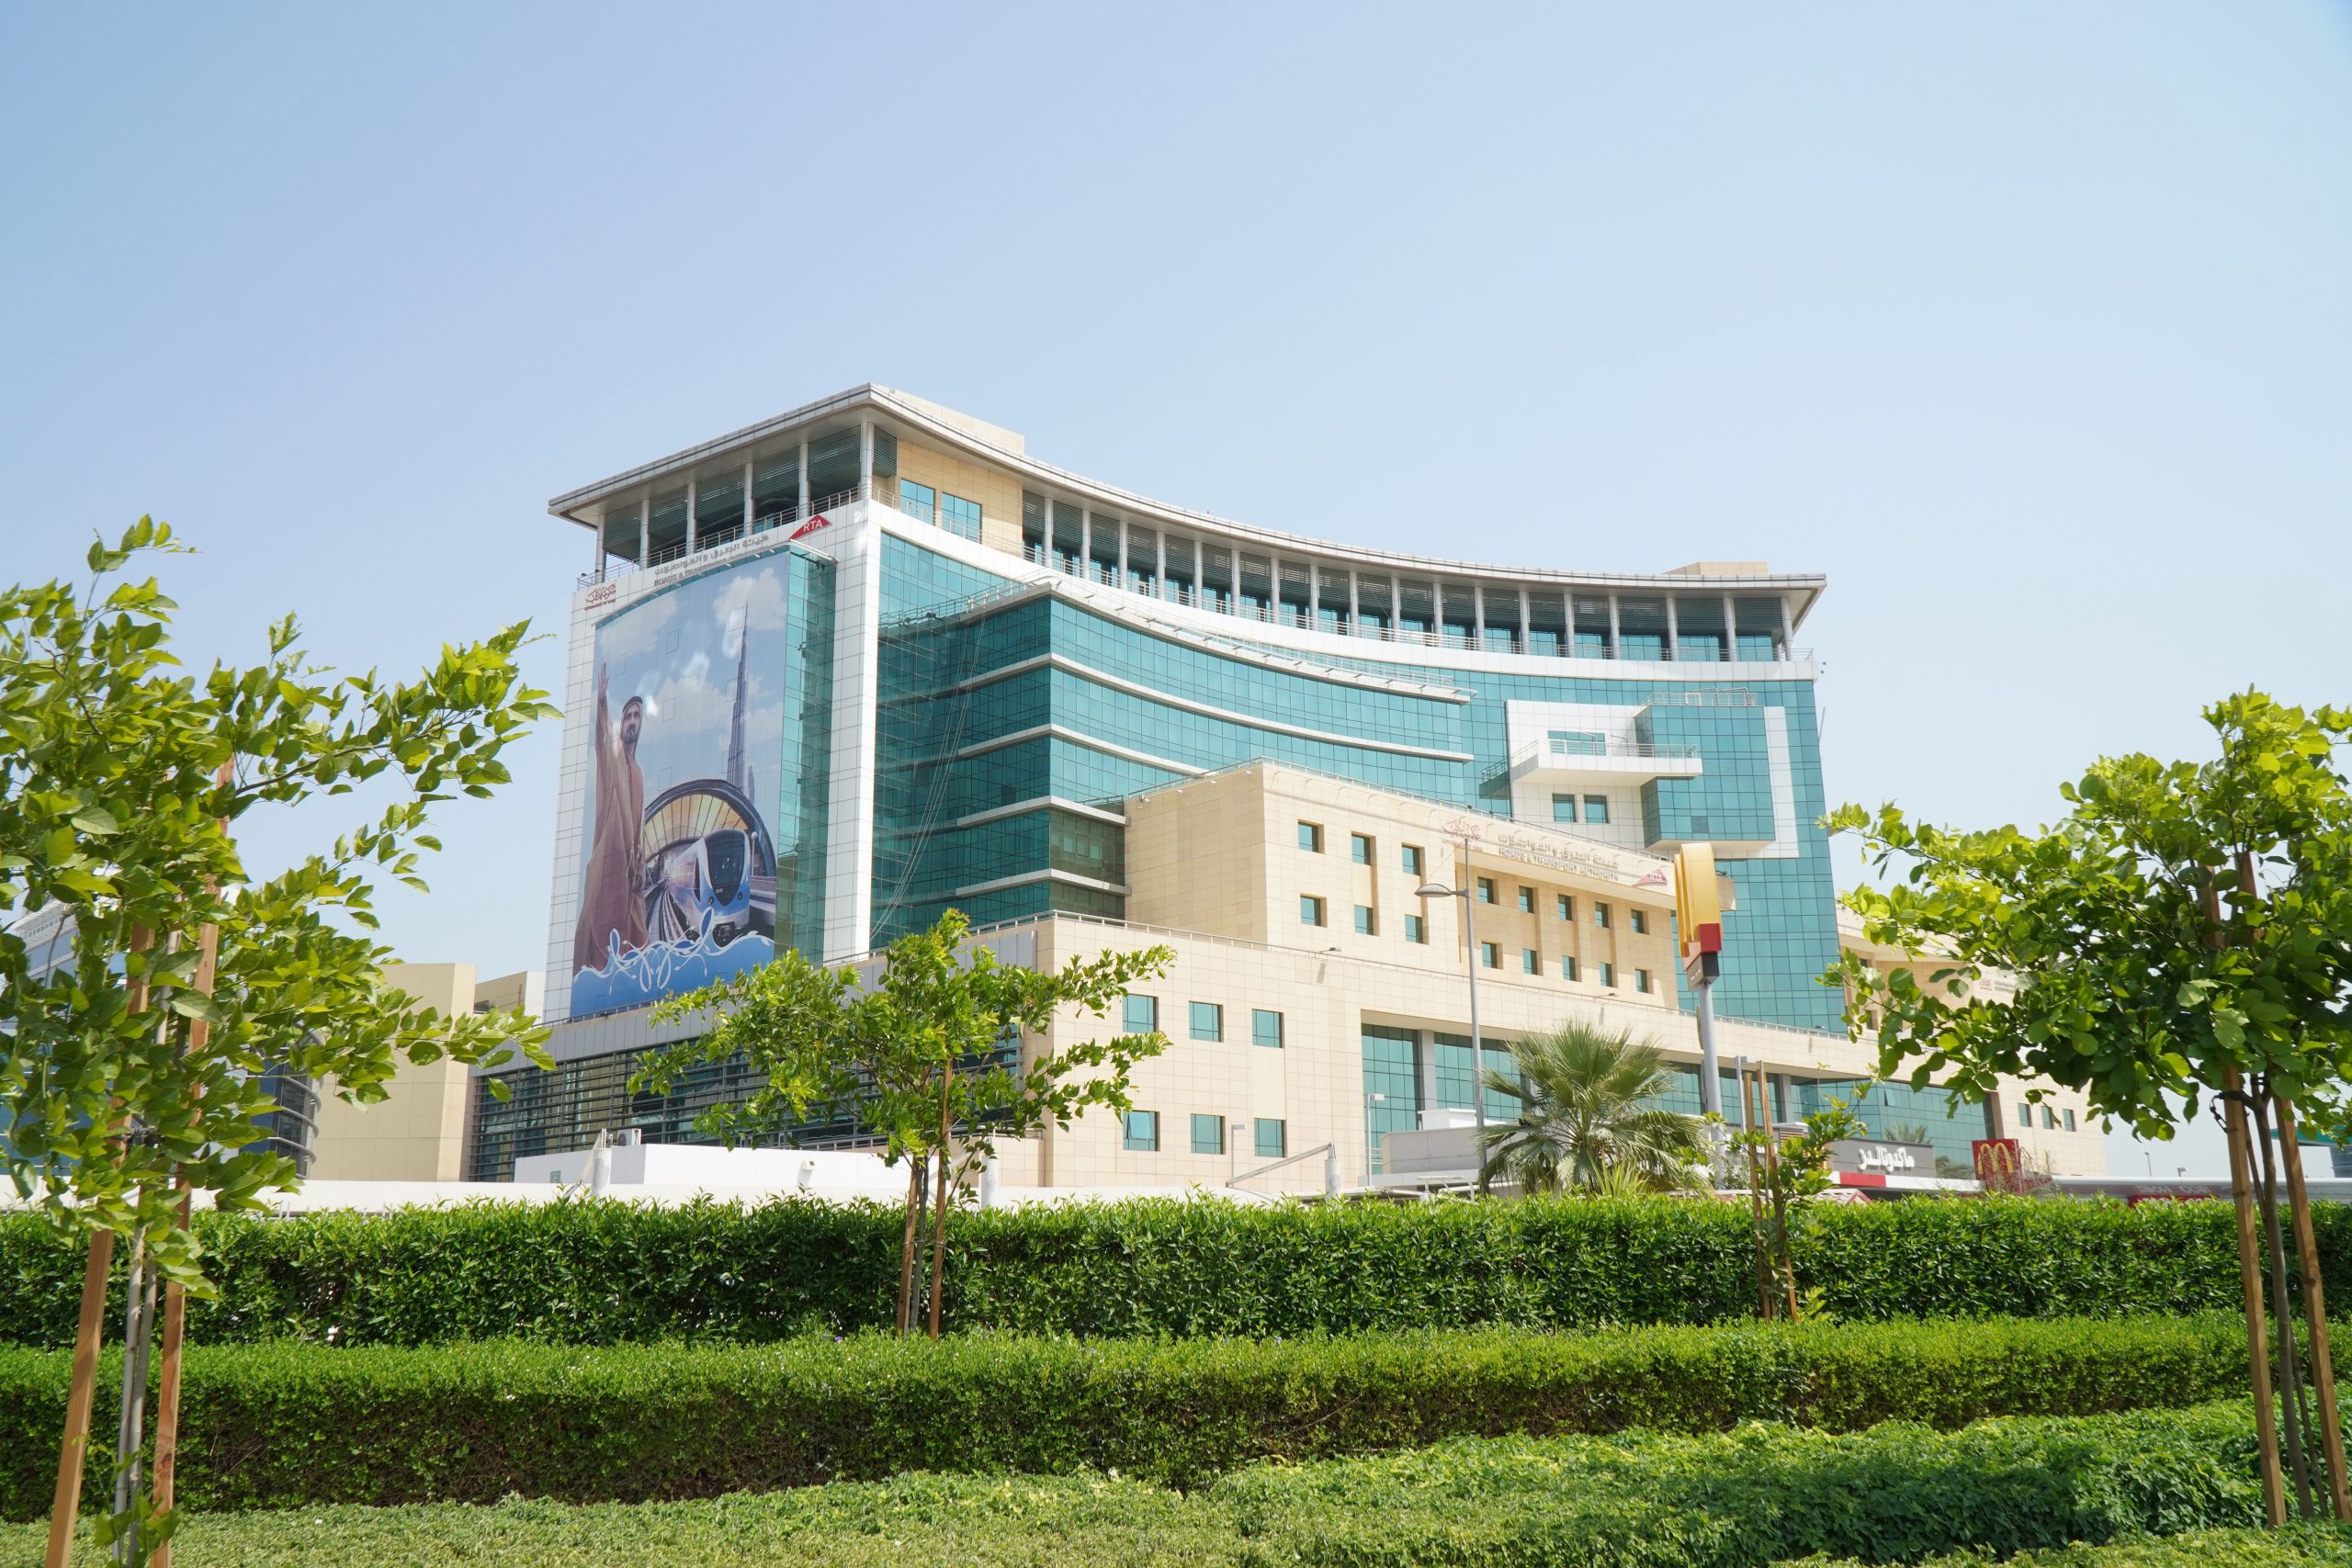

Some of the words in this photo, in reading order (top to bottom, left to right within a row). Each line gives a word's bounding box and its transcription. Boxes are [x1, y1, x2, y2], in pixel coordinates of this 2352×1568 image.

[803, 519, 823, 533] RTA
[710, 543, 740, 559] الطرق
[654, 553, 707, 574] والمواصلات
[653, 573, 677, 587] ROADS
[1498, 846, 1528, 862] ROADS
[1533, 855, 1577, 874] TRANSPORT
